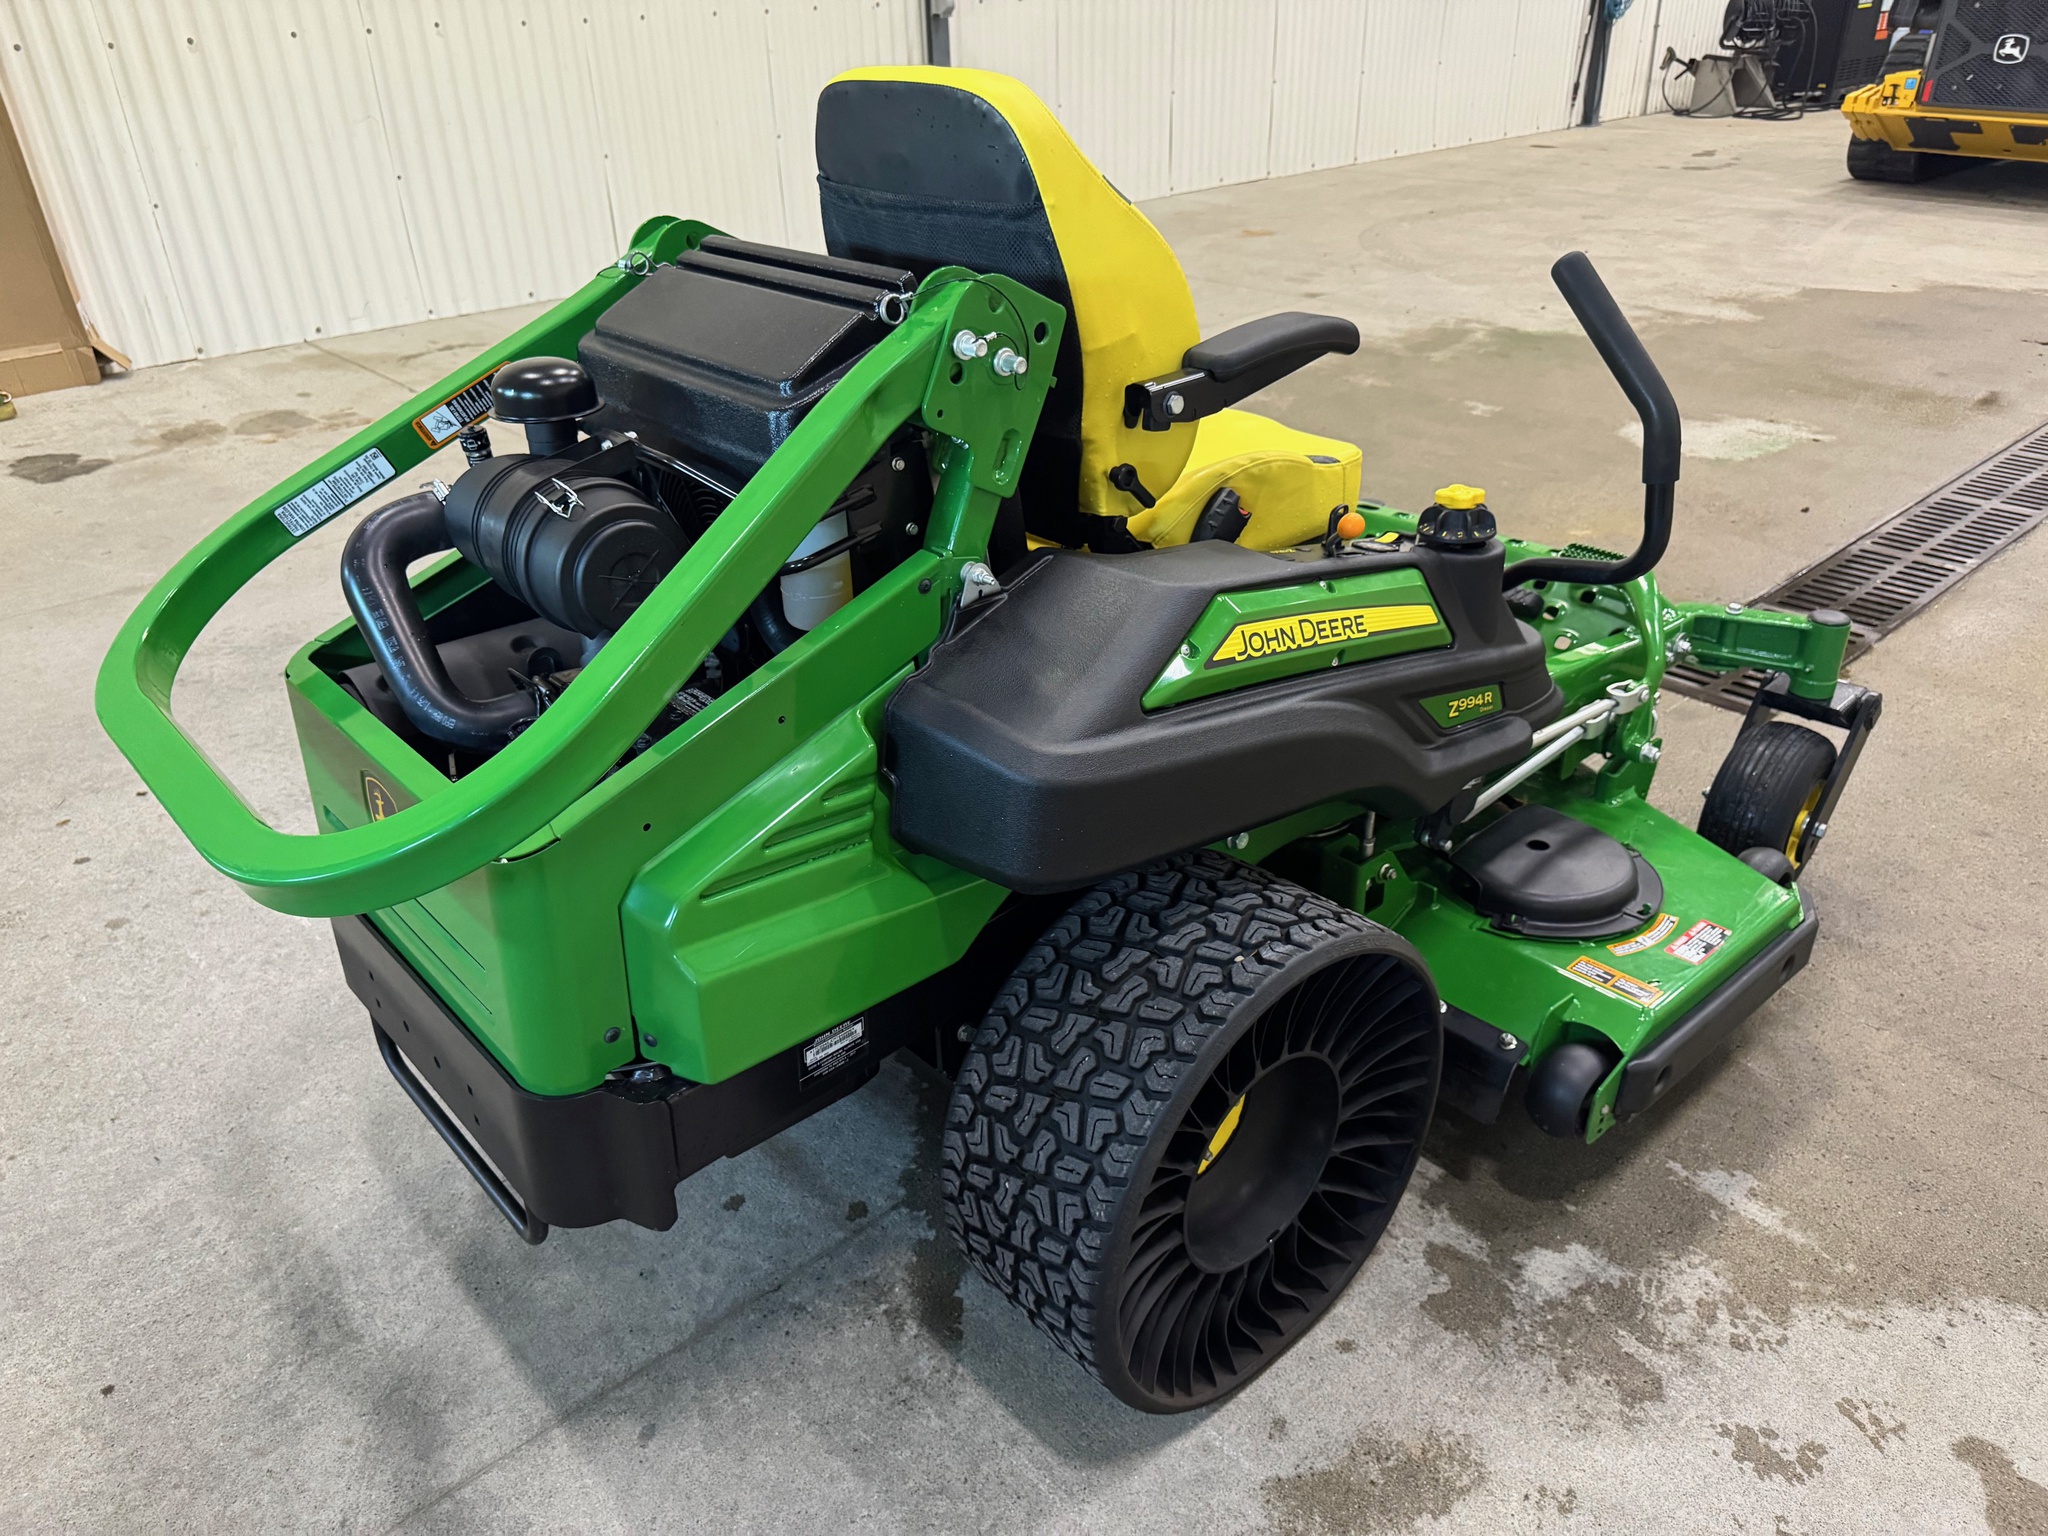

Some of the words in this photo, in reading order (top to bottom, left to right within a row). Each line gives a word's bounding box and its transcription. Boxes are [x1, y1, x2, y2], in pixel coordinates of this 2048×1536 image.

[1237, 625, 1297, 657] JOHN
[1297, 614, 1368, 643] DEERE
[1448, 691, 1493, 718] Z994R
